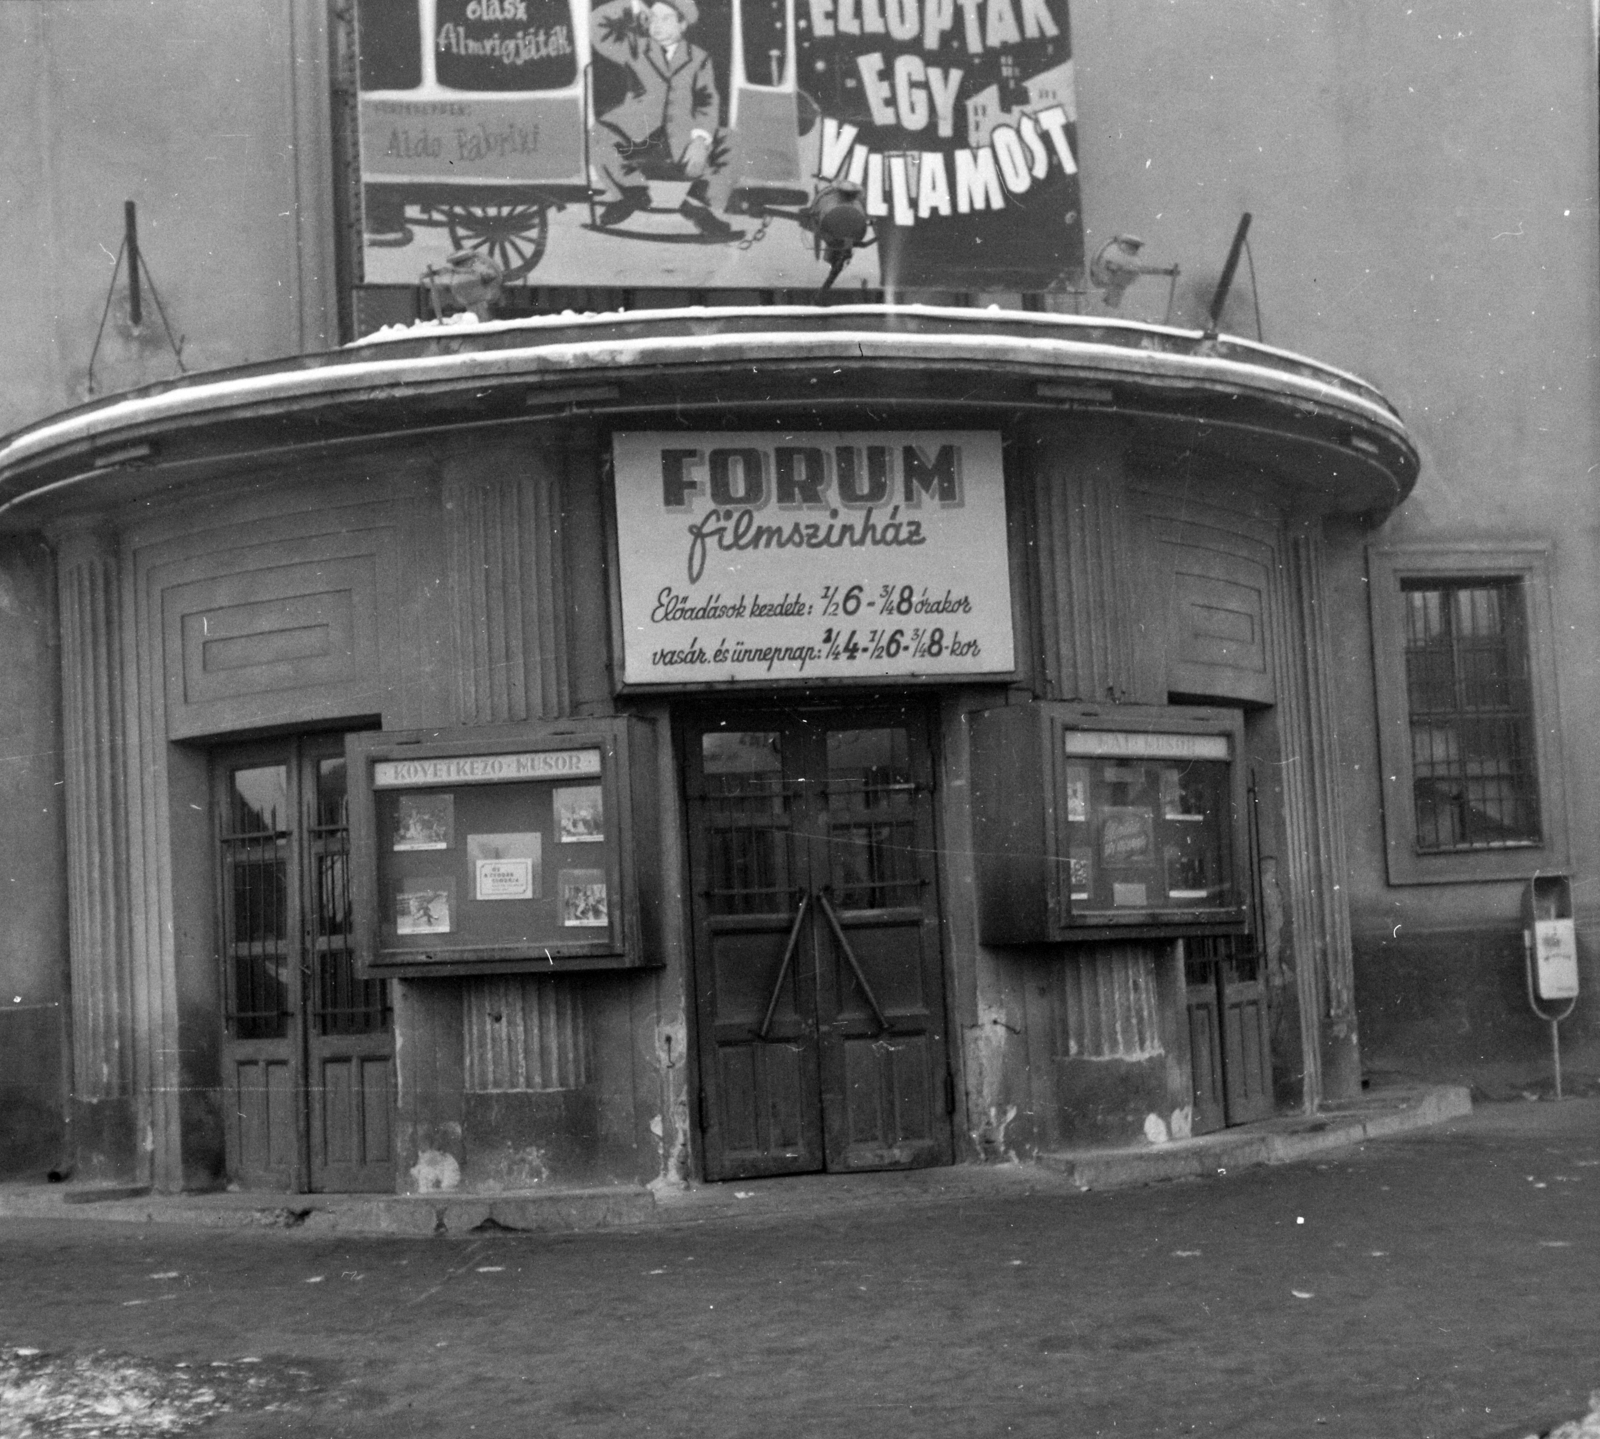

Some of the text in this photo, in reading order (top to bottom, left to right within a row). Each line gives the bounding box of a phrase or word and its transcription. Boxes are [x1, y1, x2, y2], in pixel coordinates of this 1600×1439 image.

[856, 52, 964, 138] EGY
[821, 106, 1078, 226] VILLAMOST
[661, 445, 964, 513] FORUM
[688, 505, 926, 585] filmszinház
[651, 586, 747, 623] Előadások
[749, 592, 813, 618] kezdete:
